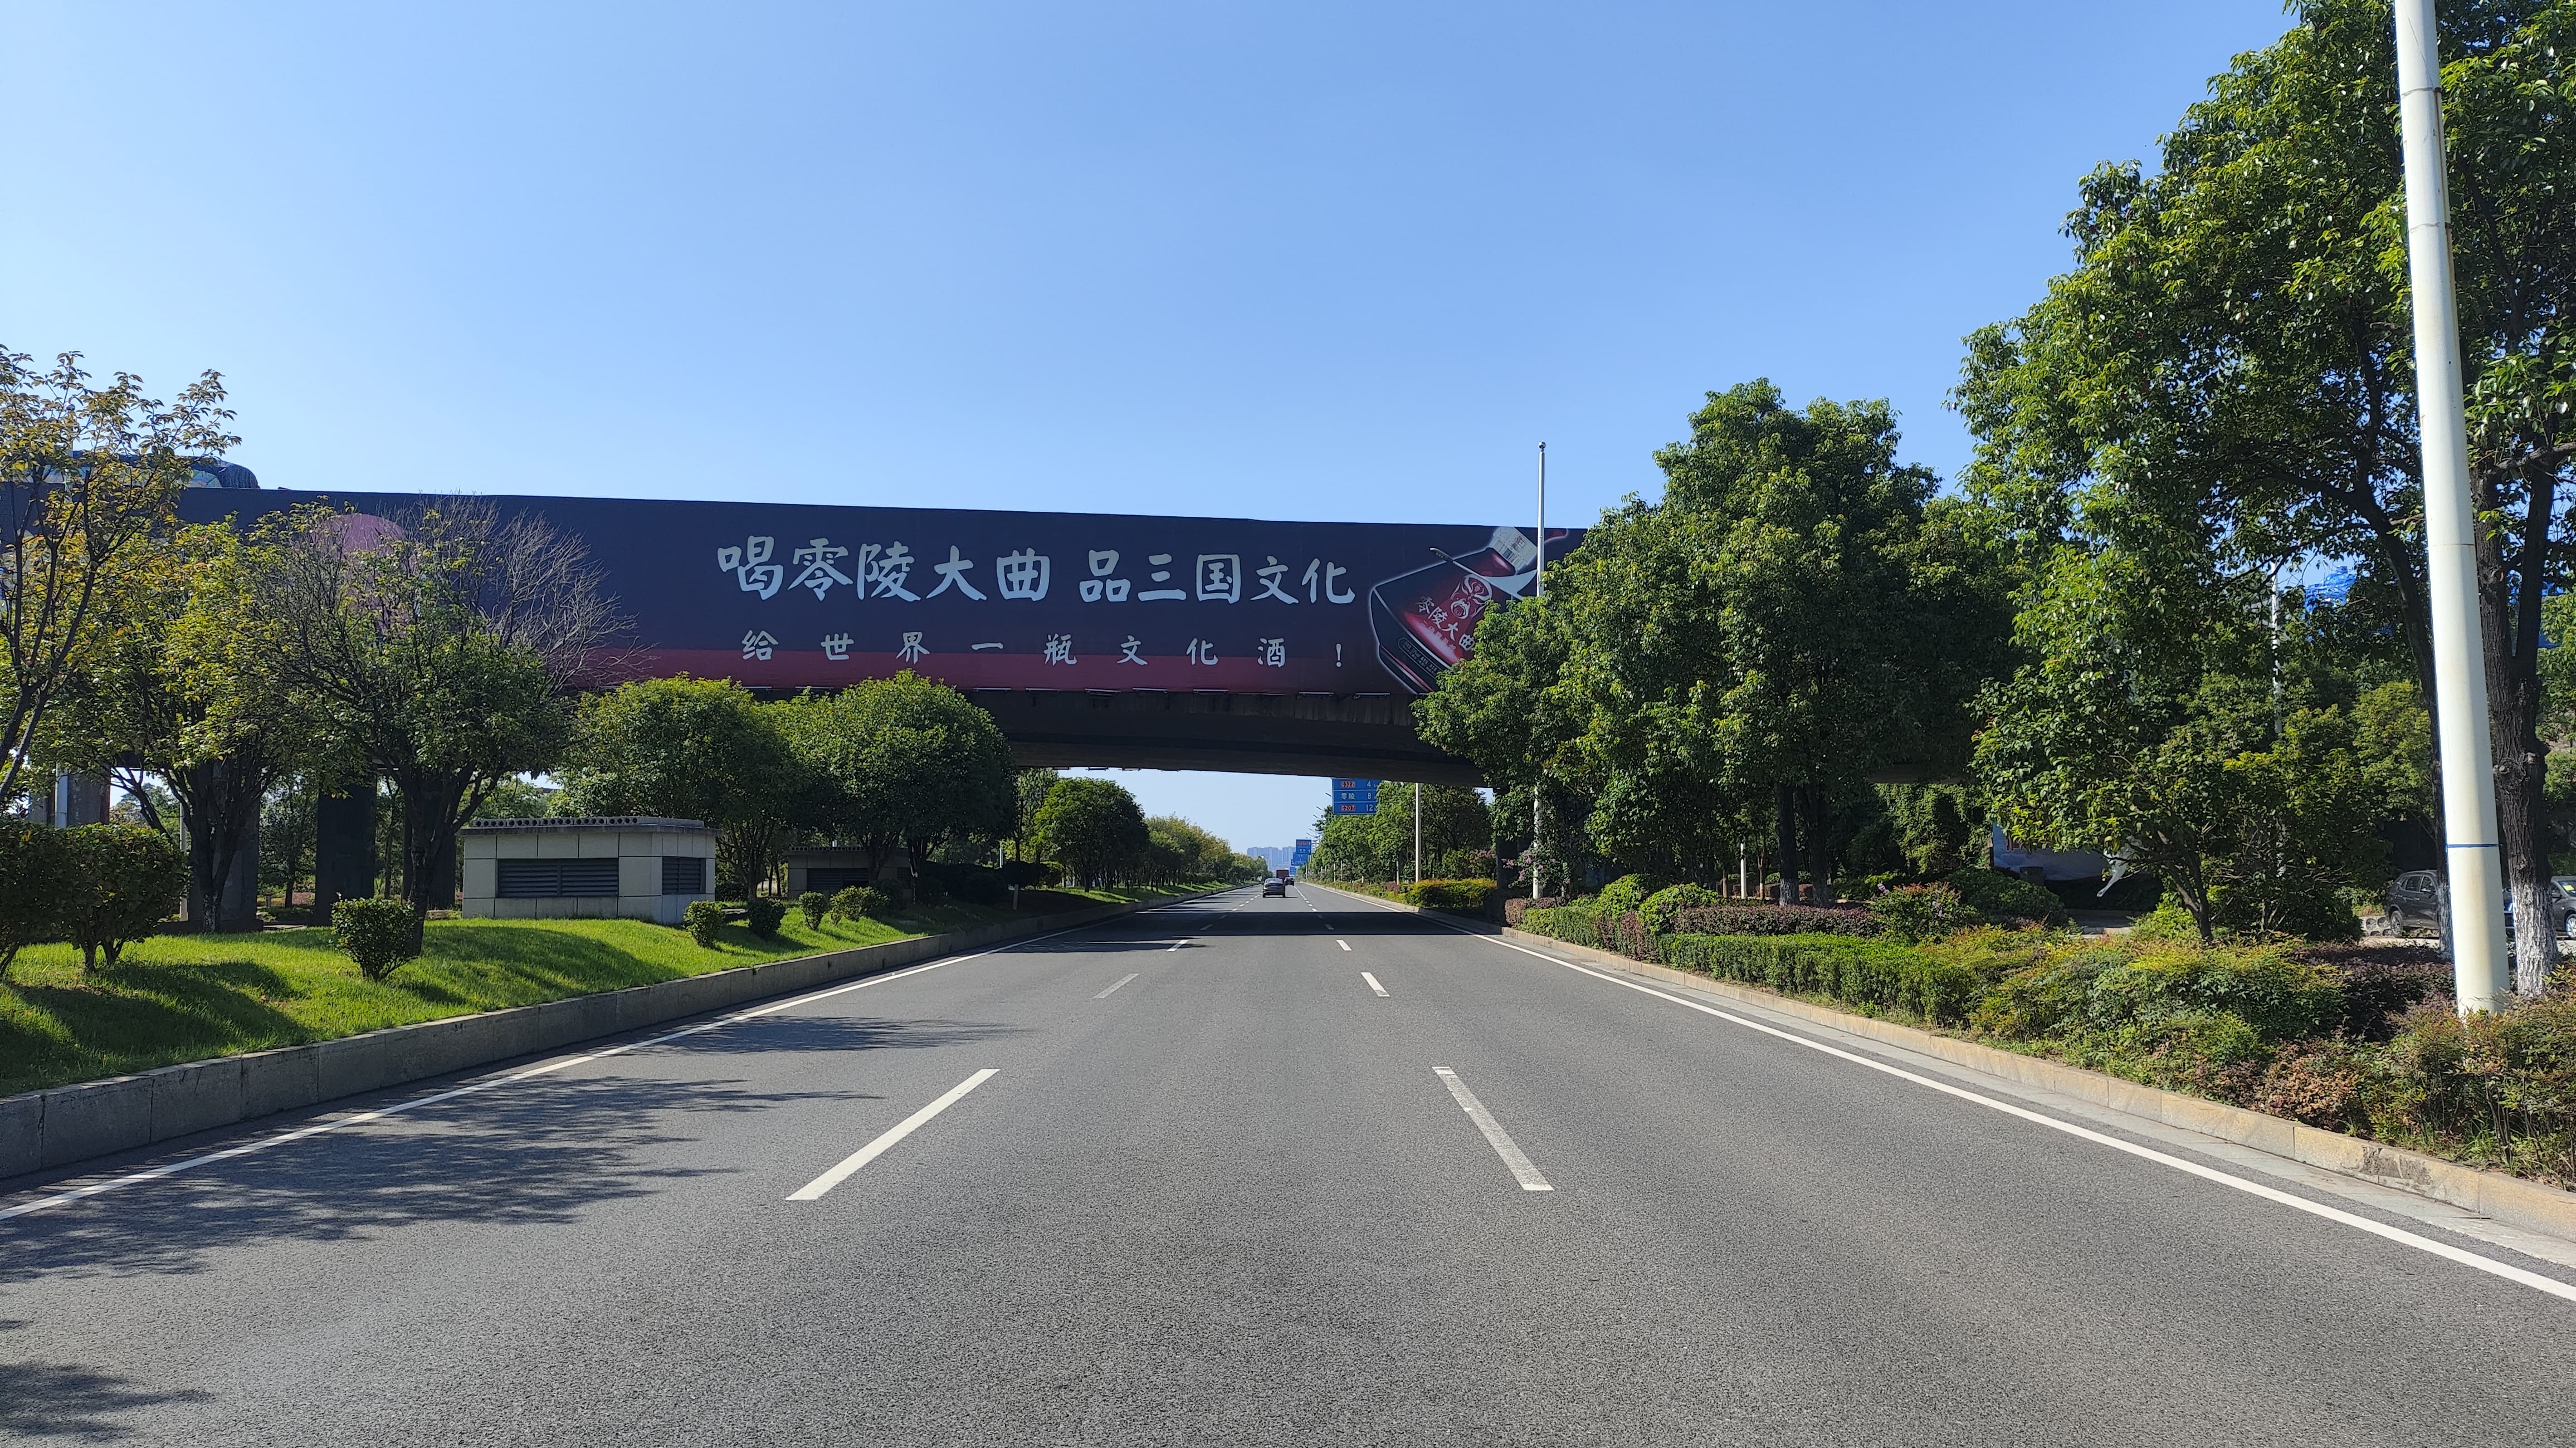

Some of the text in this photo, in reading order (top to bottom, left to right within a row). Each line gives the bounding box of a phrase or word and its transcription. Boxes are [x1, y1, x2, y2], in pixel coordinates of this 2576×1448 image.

[717, 535, 1355, 605] 喝零陵大曲 品三国文化
[1415, 596, 1476, 650] 零陵大曲
